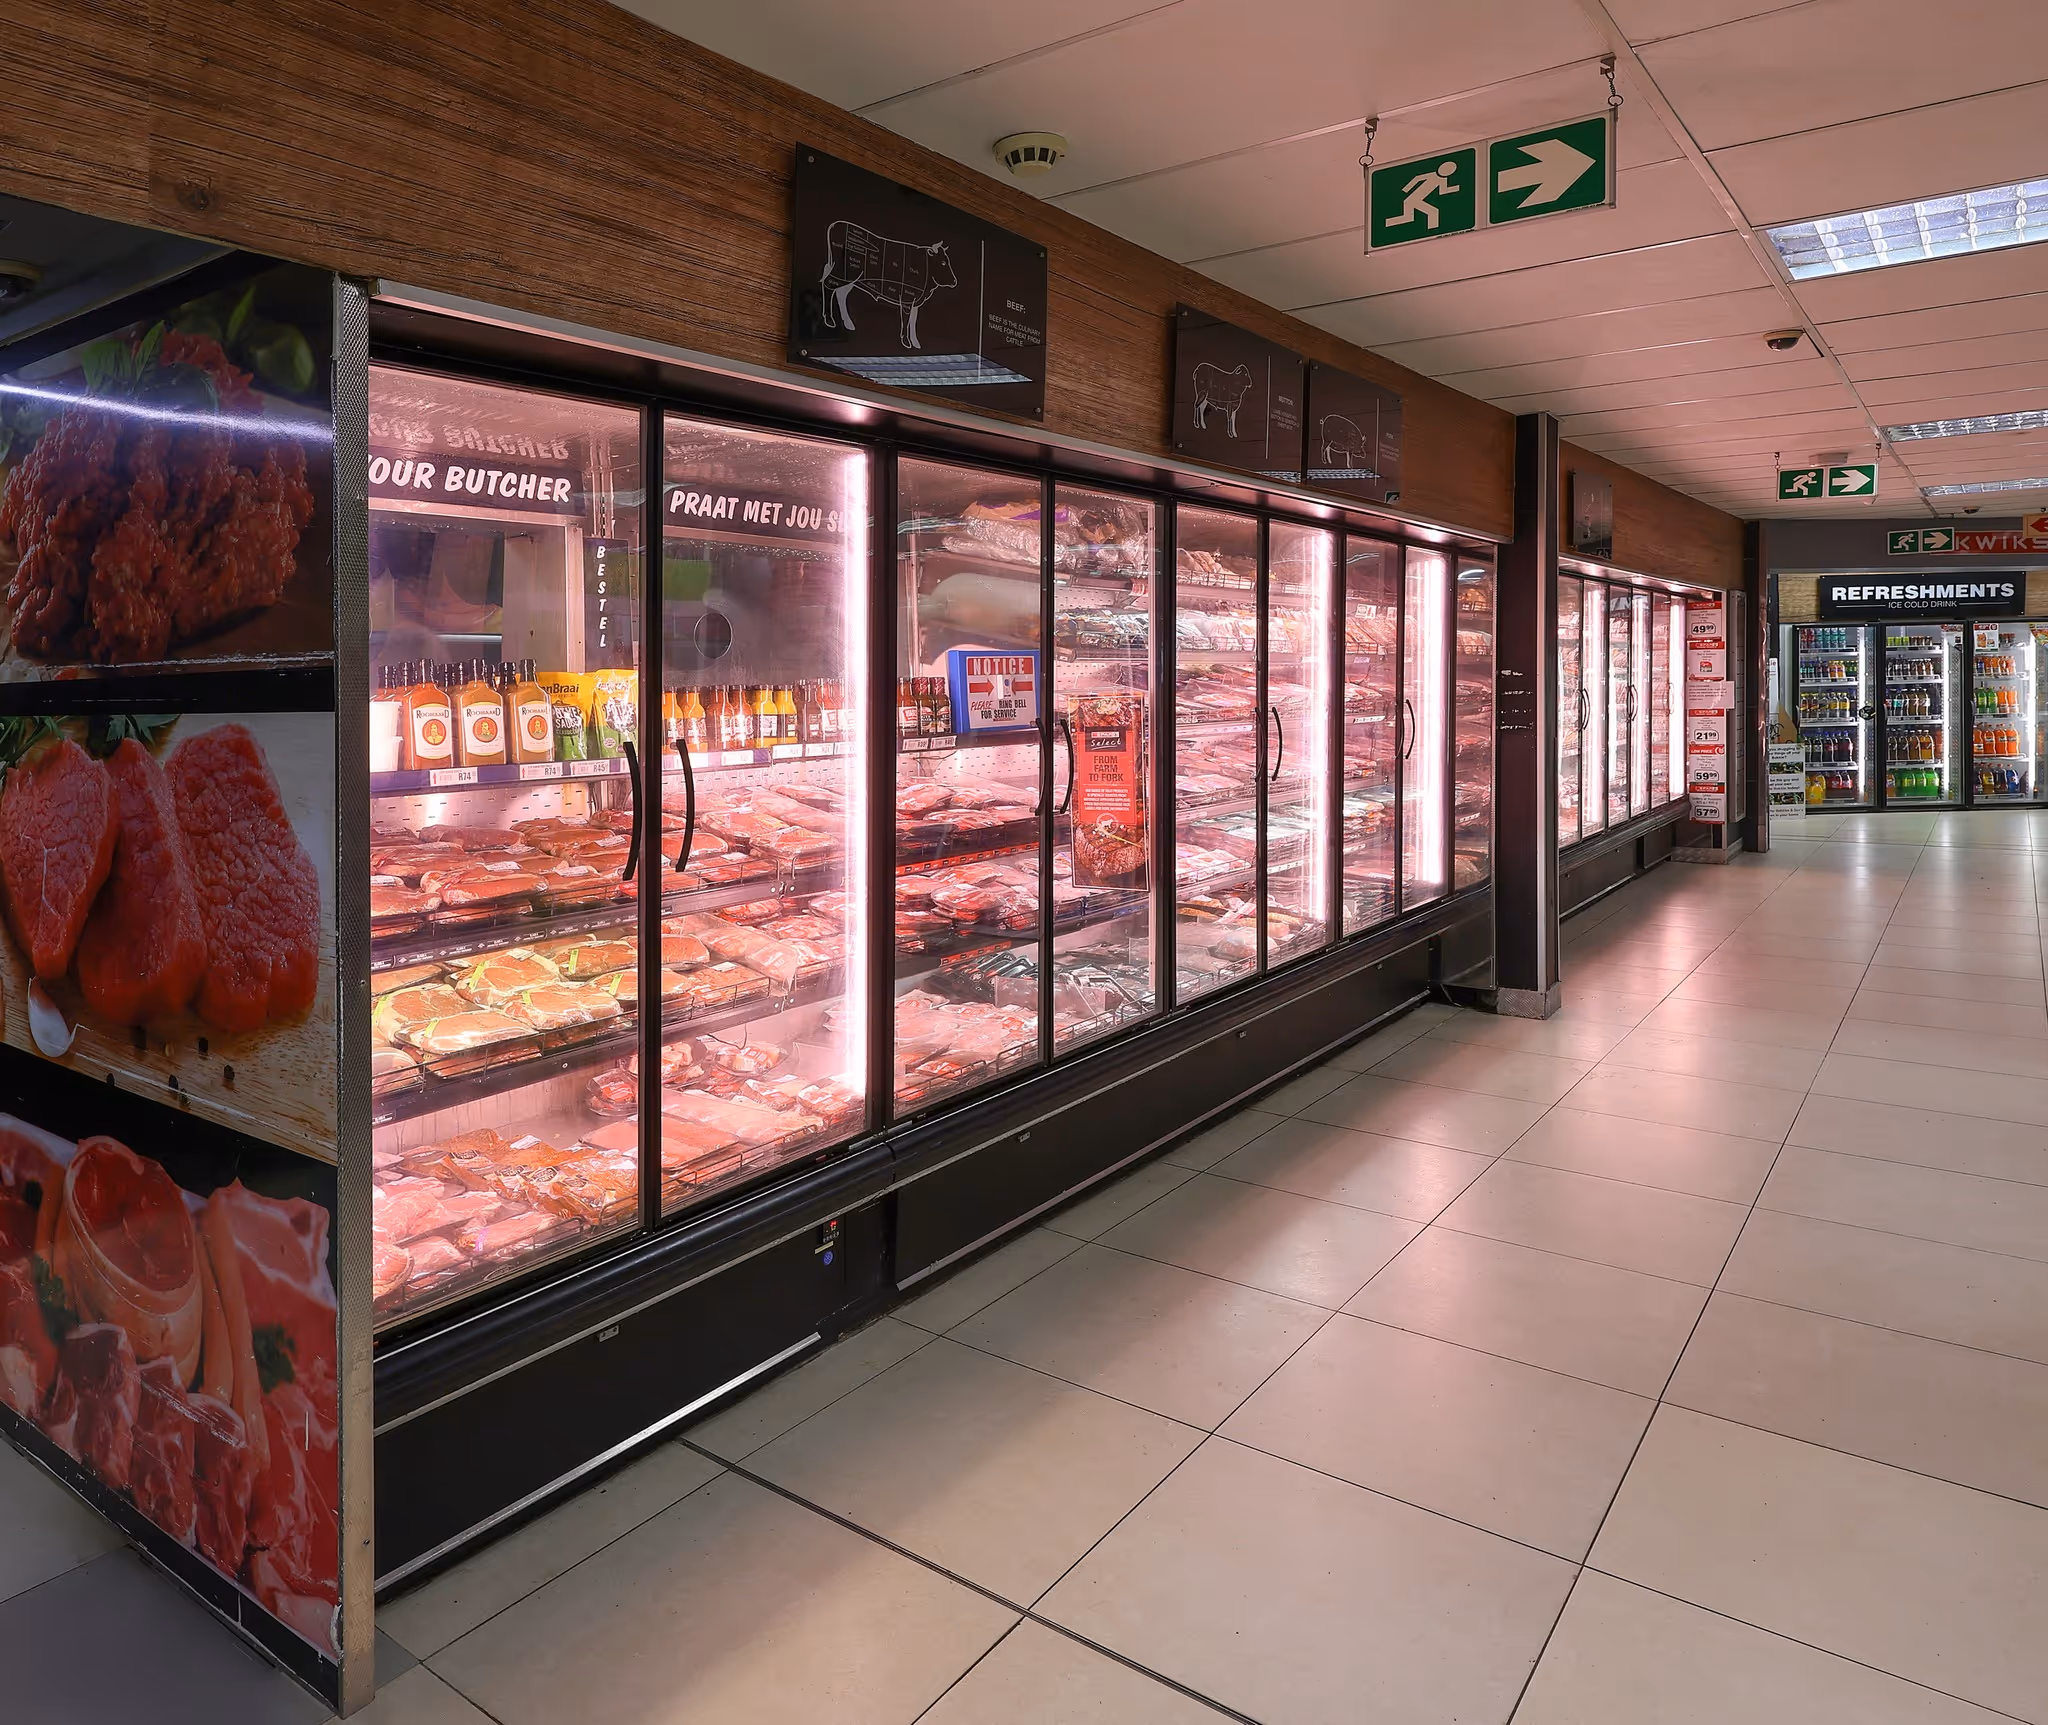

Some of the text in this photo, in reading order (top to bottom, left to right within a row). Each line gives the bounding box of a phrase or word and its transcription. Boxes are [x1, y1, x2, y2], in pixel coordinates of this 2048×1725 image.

[1006, 299, 1026, 314] BEEF:
[368, 455, 572, 503] OUR BUTCHER
[669, 490, 740, 520] PRAAT
[743, 500, 783, 525] MET
[785, 505, 823, 530] JOU
[596, 545, 608, 648] BESTEL
[1832, 583, 2015, 601] REFRESHMENTS
[1888, 600, 1957, 609] ICE COLD DRINK
[973, 658, 1025, 675] NOTICE
[970, 699, 1027, 711] PLEASE RING BELL
[981, 708, 1017, 719] FOR SERVICE
[1090, 738, 1121, 747] Select
[1093, 755, 1118, 764] FROM
[544, 767, 556, 776] R74
[1093, 764, 1118, 773] FARM
[458, 772, 472, 781] R74
[1088, 773, 1124, 781] TO FORK
